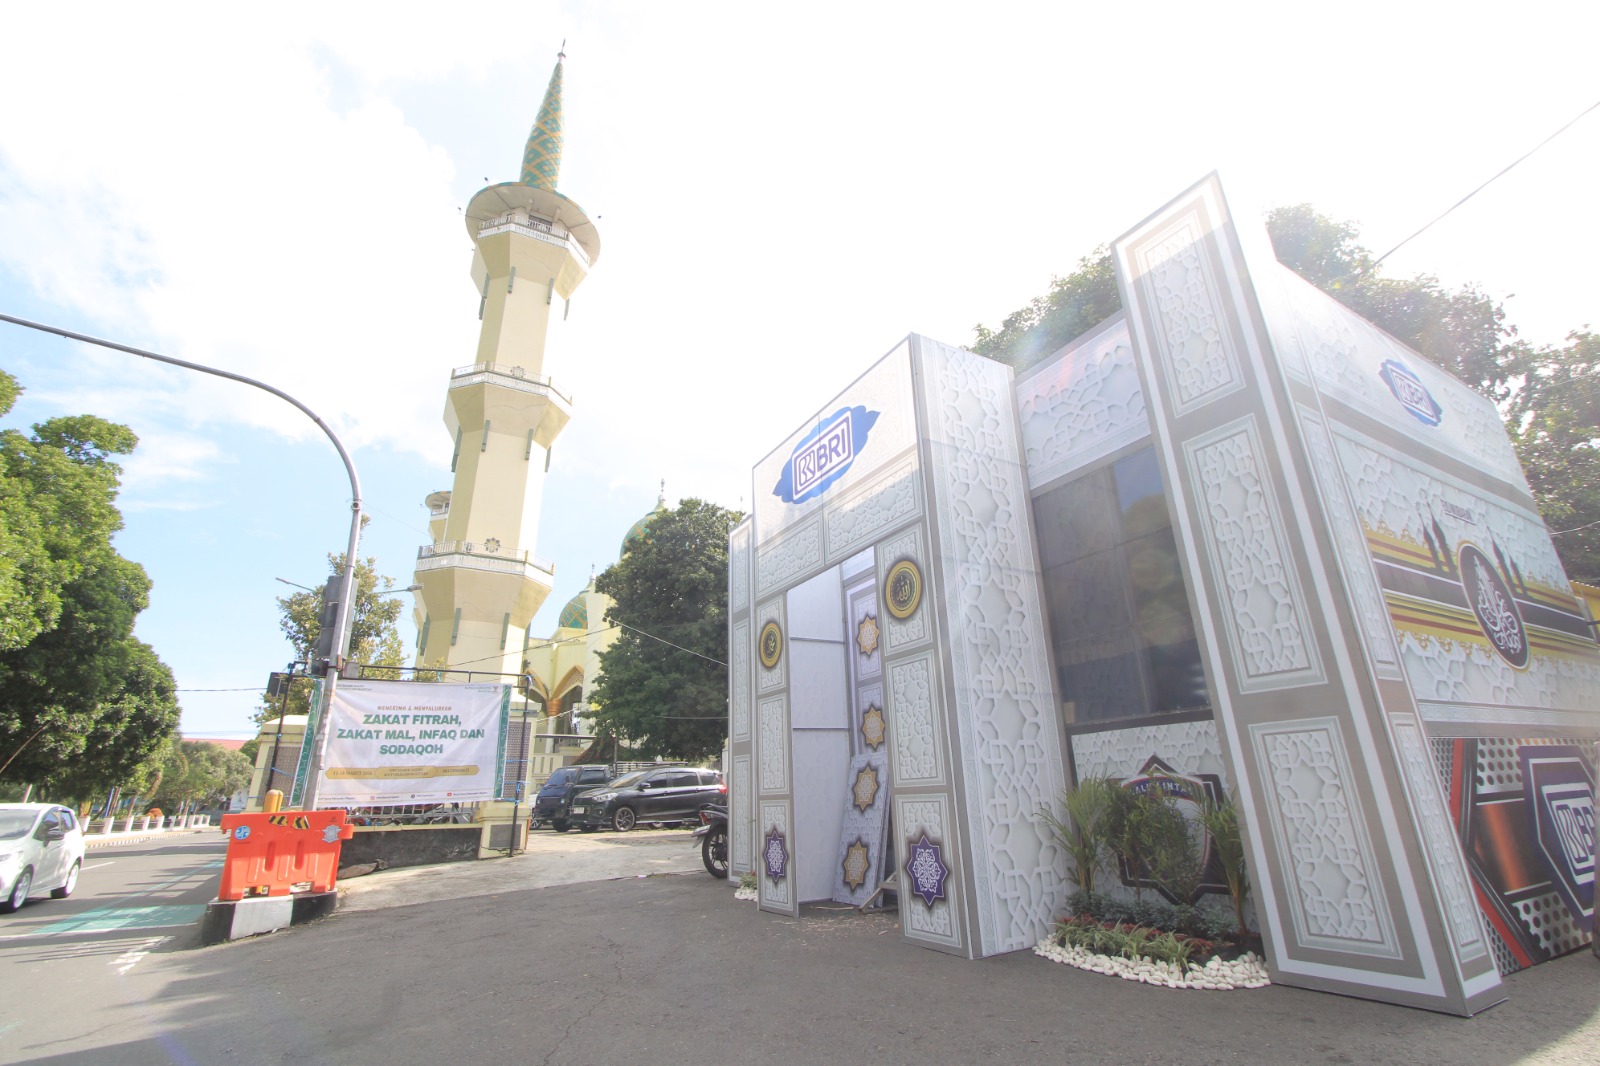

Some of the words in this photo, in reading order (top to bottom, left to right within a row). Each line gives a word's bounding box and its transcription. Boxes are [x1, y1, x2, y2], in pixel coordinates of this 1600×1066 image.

[816, 428, 846, 473] BRI
[363, 714, 410, 725] ZAKAT
[412, 714, 462, 727] FITRAH,
[337, 728, 383, 739] ZAKAT
[385, 729, 415, 741] MAL,
[418, 729, 457, 740] INFAQ
[459, 728, 485, 739] DAN
[379, 744, 444, 755] SODAQOH
